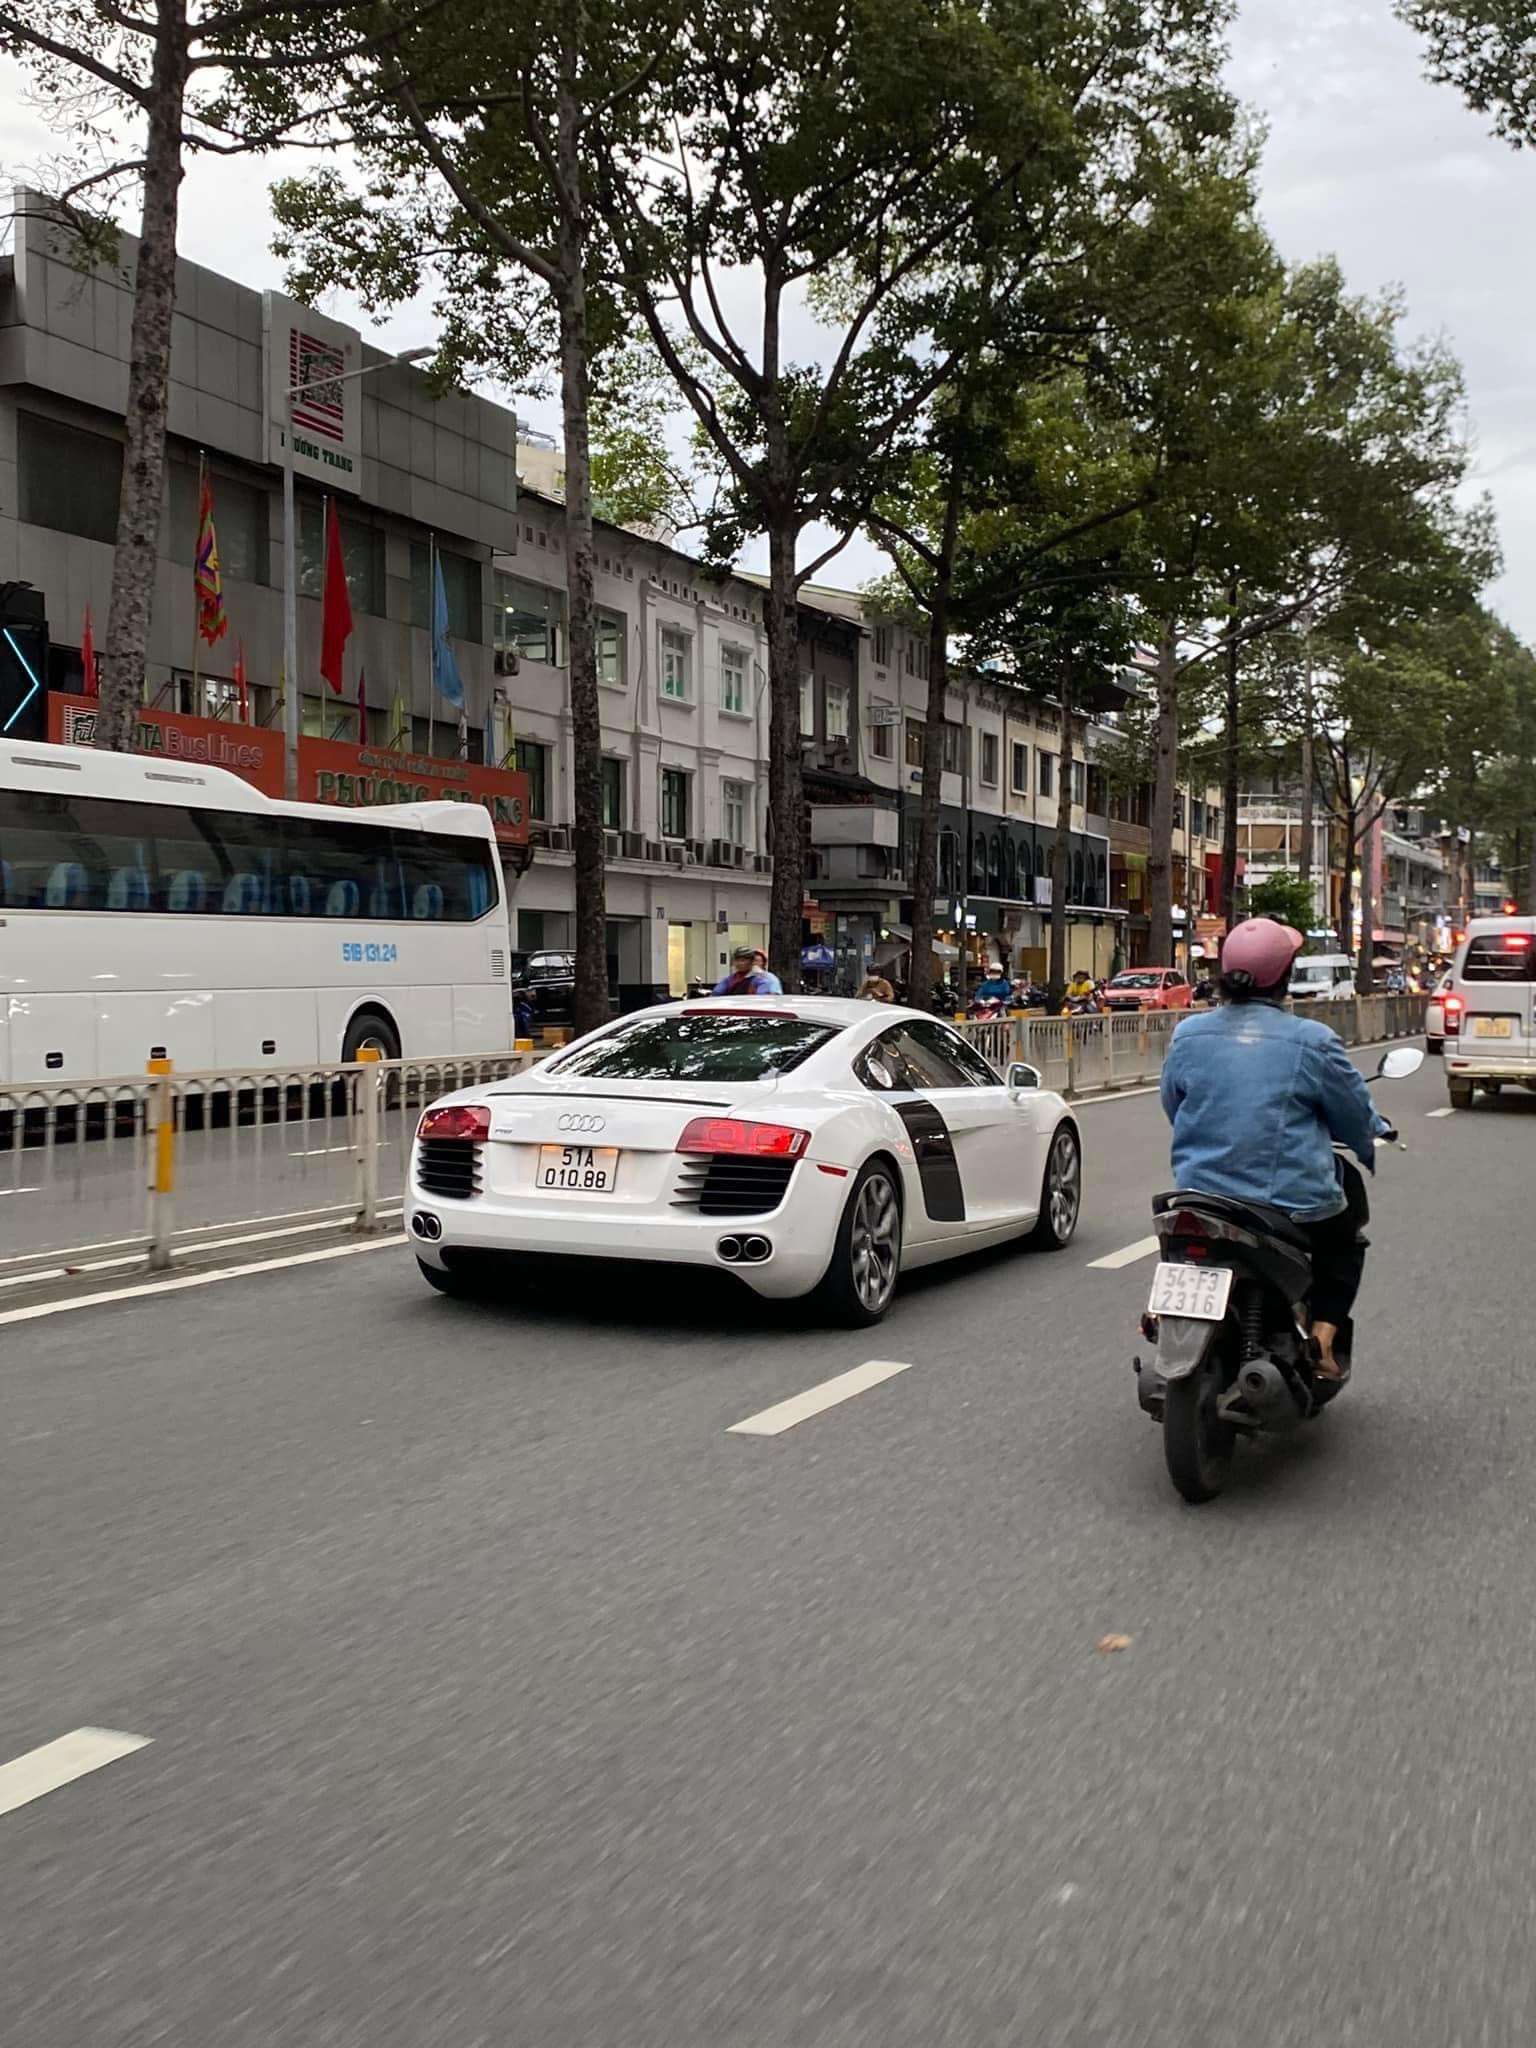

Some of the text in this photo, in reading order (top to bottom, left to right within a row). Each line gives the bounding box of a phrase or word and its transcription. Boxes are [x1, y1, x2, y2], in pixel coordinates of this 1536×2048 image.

[322, 448, 352, 472] TRANG
[562, 1148, 594, 1168] 51A
[545, 1168, 606, 1188] 010.88
[1165, 1268, 1218, 1292] 54-F3
[1161, 1290, 1215, 1313] 2316
